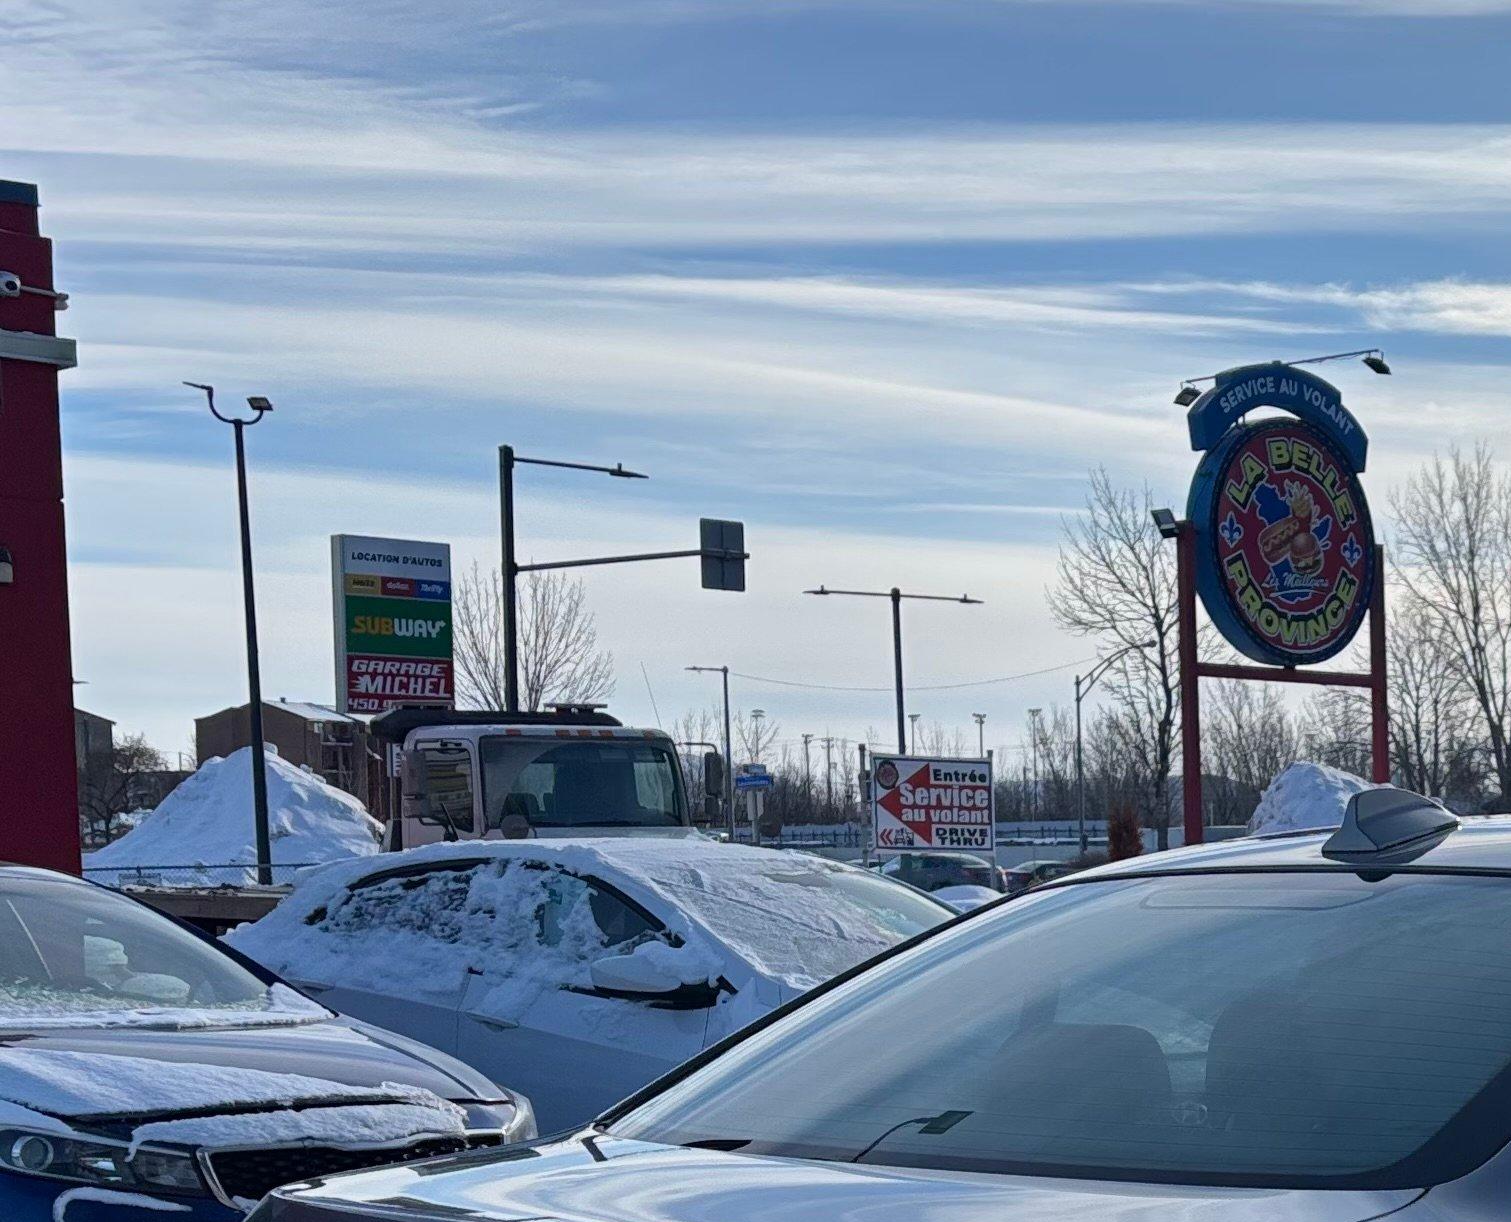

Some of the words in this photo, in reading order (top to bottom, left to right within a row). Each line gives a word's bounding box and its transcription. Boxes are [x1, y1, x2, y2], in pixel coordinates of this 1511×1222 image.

[1219, 376, 1275, 414] SERVICE
[1279, 378, 1299, 396] AU
[1302, 383, 1355, 435] VOLANT
[1227, 453, 1267, 513] LA
[1266, 438, 1356, 530] BELLE
[351, 552, 400, 564] LOCATION
[402, 556, 443, 567] D'AUTOS
[1225, 551, 1358, 645] PROVINCE
[352, 616, 447, 638] SUBWAY
[351, 659, 448, 677] GARAGE
[357, 675, 451, 697] MICHEL
[932, 768, 987, 783] Entrée
[899, 783, 989, 808] Service
[901, 808, 926, 822] au
[929, 807, 990, 824] volant
[935, 828, 988, 838] DRIVE
[938, 837, 986, 846] THRU
